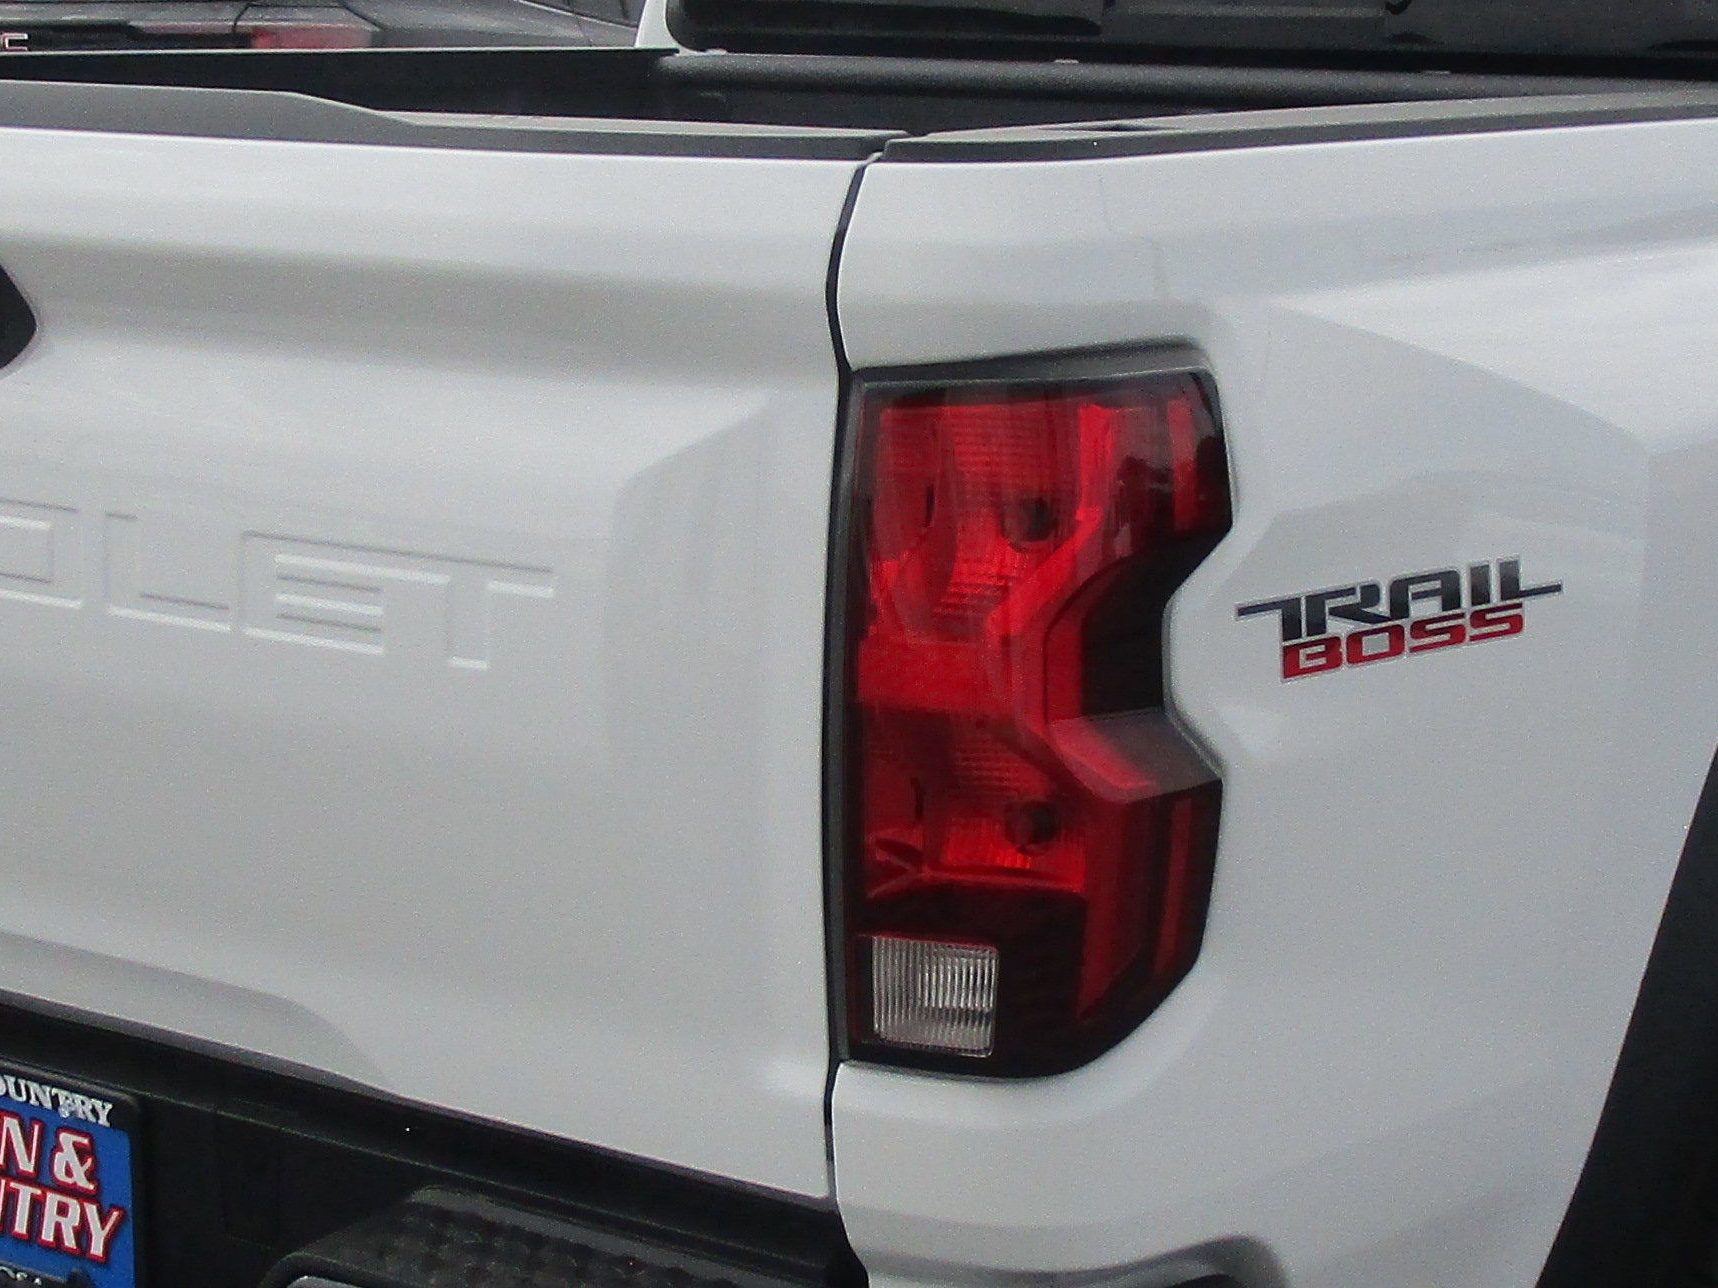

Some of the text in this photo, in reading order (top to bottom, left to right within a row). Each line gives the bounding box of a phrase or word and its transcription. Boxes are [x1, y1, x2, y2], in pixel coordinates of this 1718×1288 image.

[1235, 554, 1563, 643] TRAIL
[1280, 602, 1525, 682] BOSS
[51, 1128, 98, 1193] &
